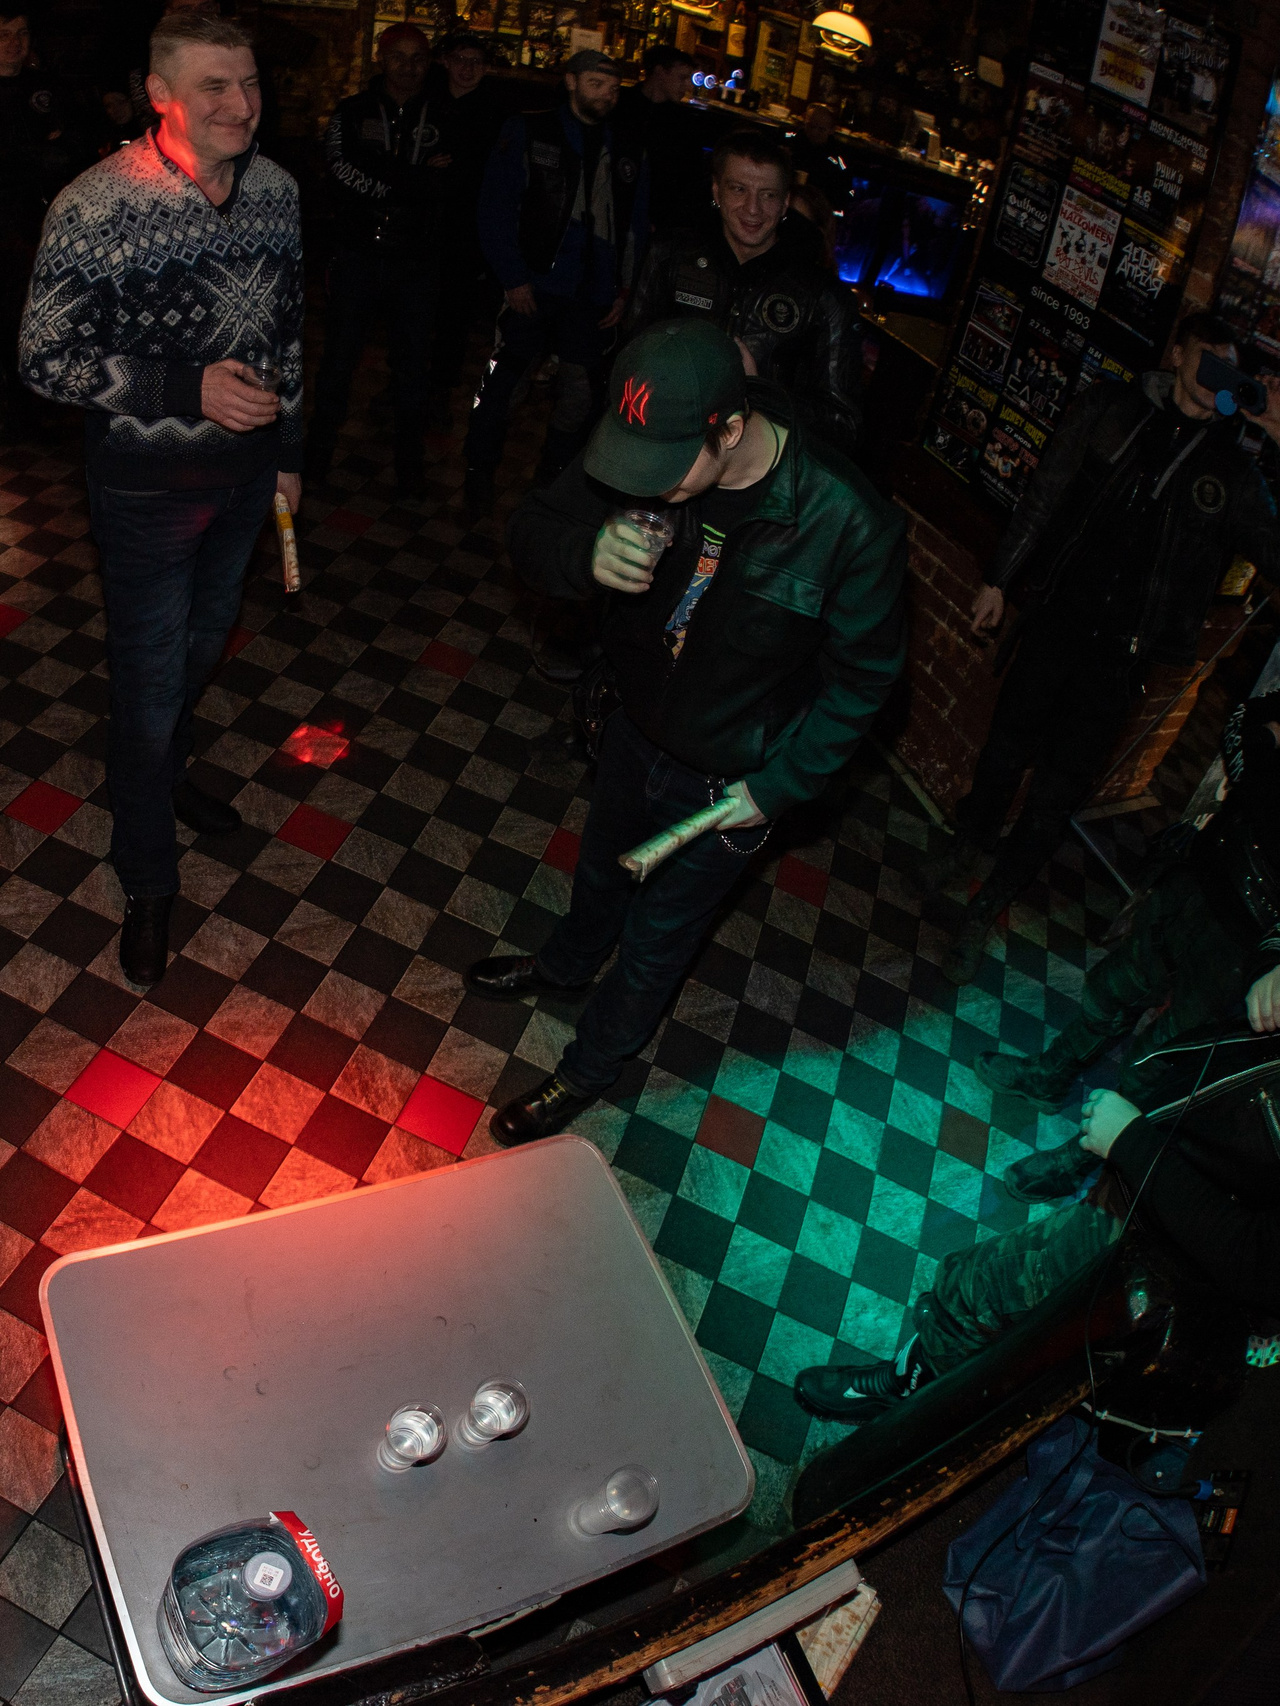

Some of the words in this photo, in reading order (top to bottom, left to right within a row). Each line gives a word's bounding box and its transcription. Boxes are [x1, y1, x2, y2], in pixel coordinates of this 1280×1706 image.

[1059, 206, 1115, 246] HALLOWEEN
[1031, 284, 1060, 310] since
[1062, 303, 1091, 330] 1993
[297, 1528, 342, 1599] УДОБНО
